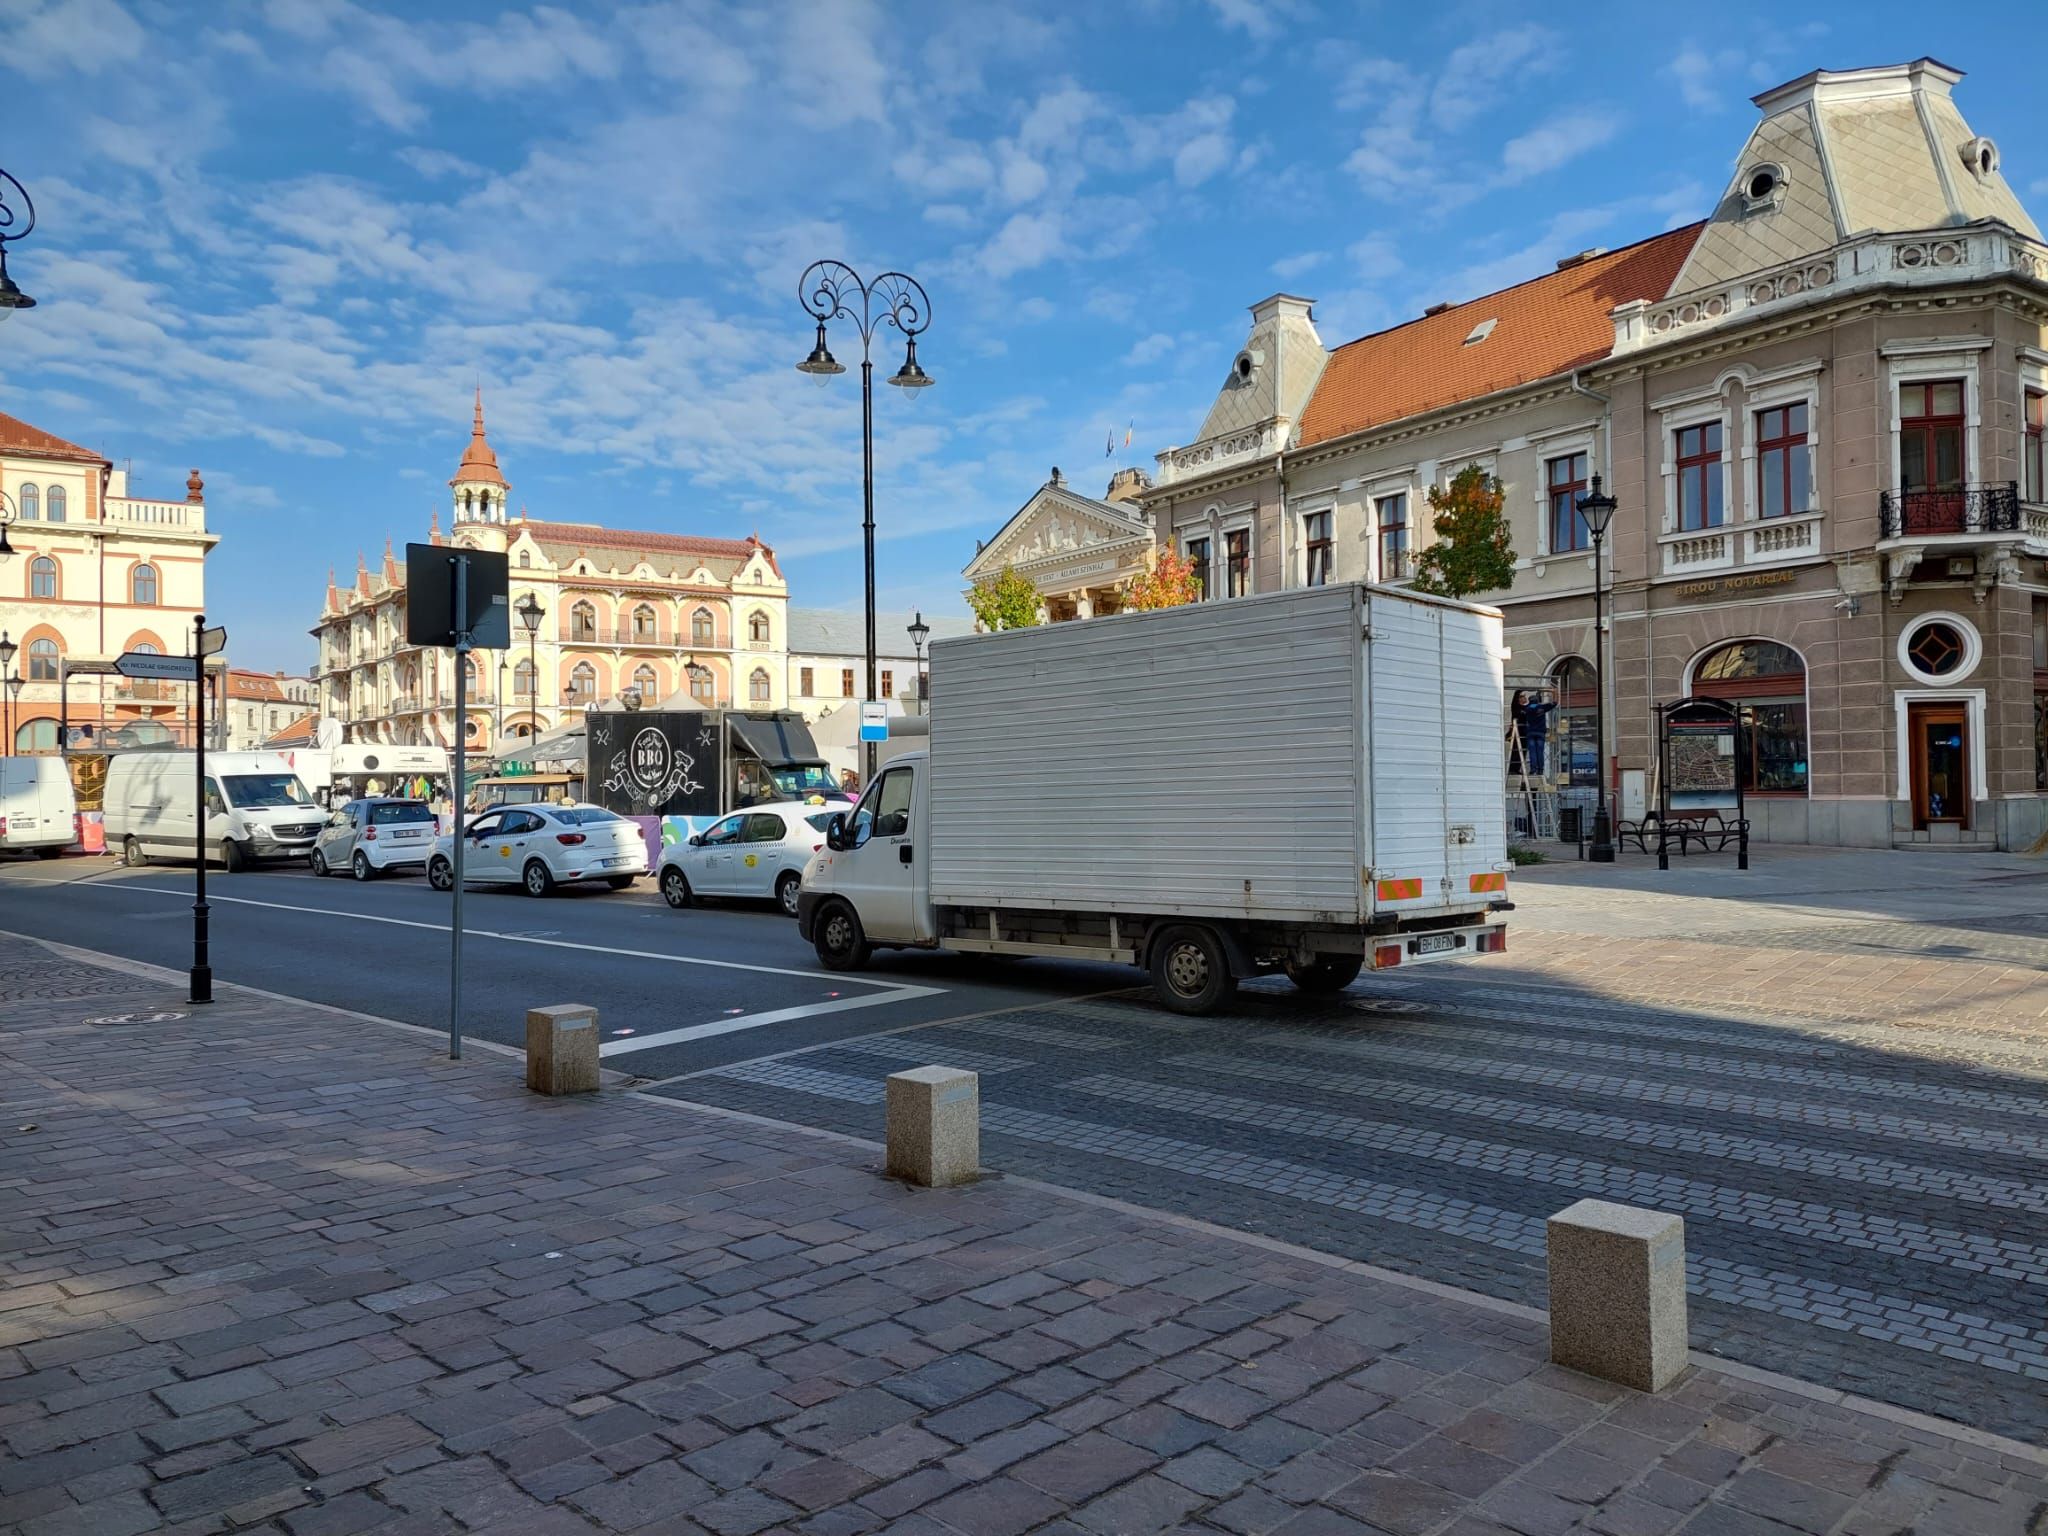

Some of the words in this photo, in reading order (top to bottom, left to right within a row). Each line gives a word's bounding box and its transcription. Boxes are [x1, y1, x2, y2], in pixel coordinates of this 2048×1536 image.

[1675, 582, 1717, 597] BIROU
[1724, 570, 1794, 589] NOTARIAL
[157, 664, 193, 672] GRIGORESCU
[637, 749, 663, 766] BBQ
[890, 837, 911, 845] Ducato
[1422, 937, 1433, 951] BH
